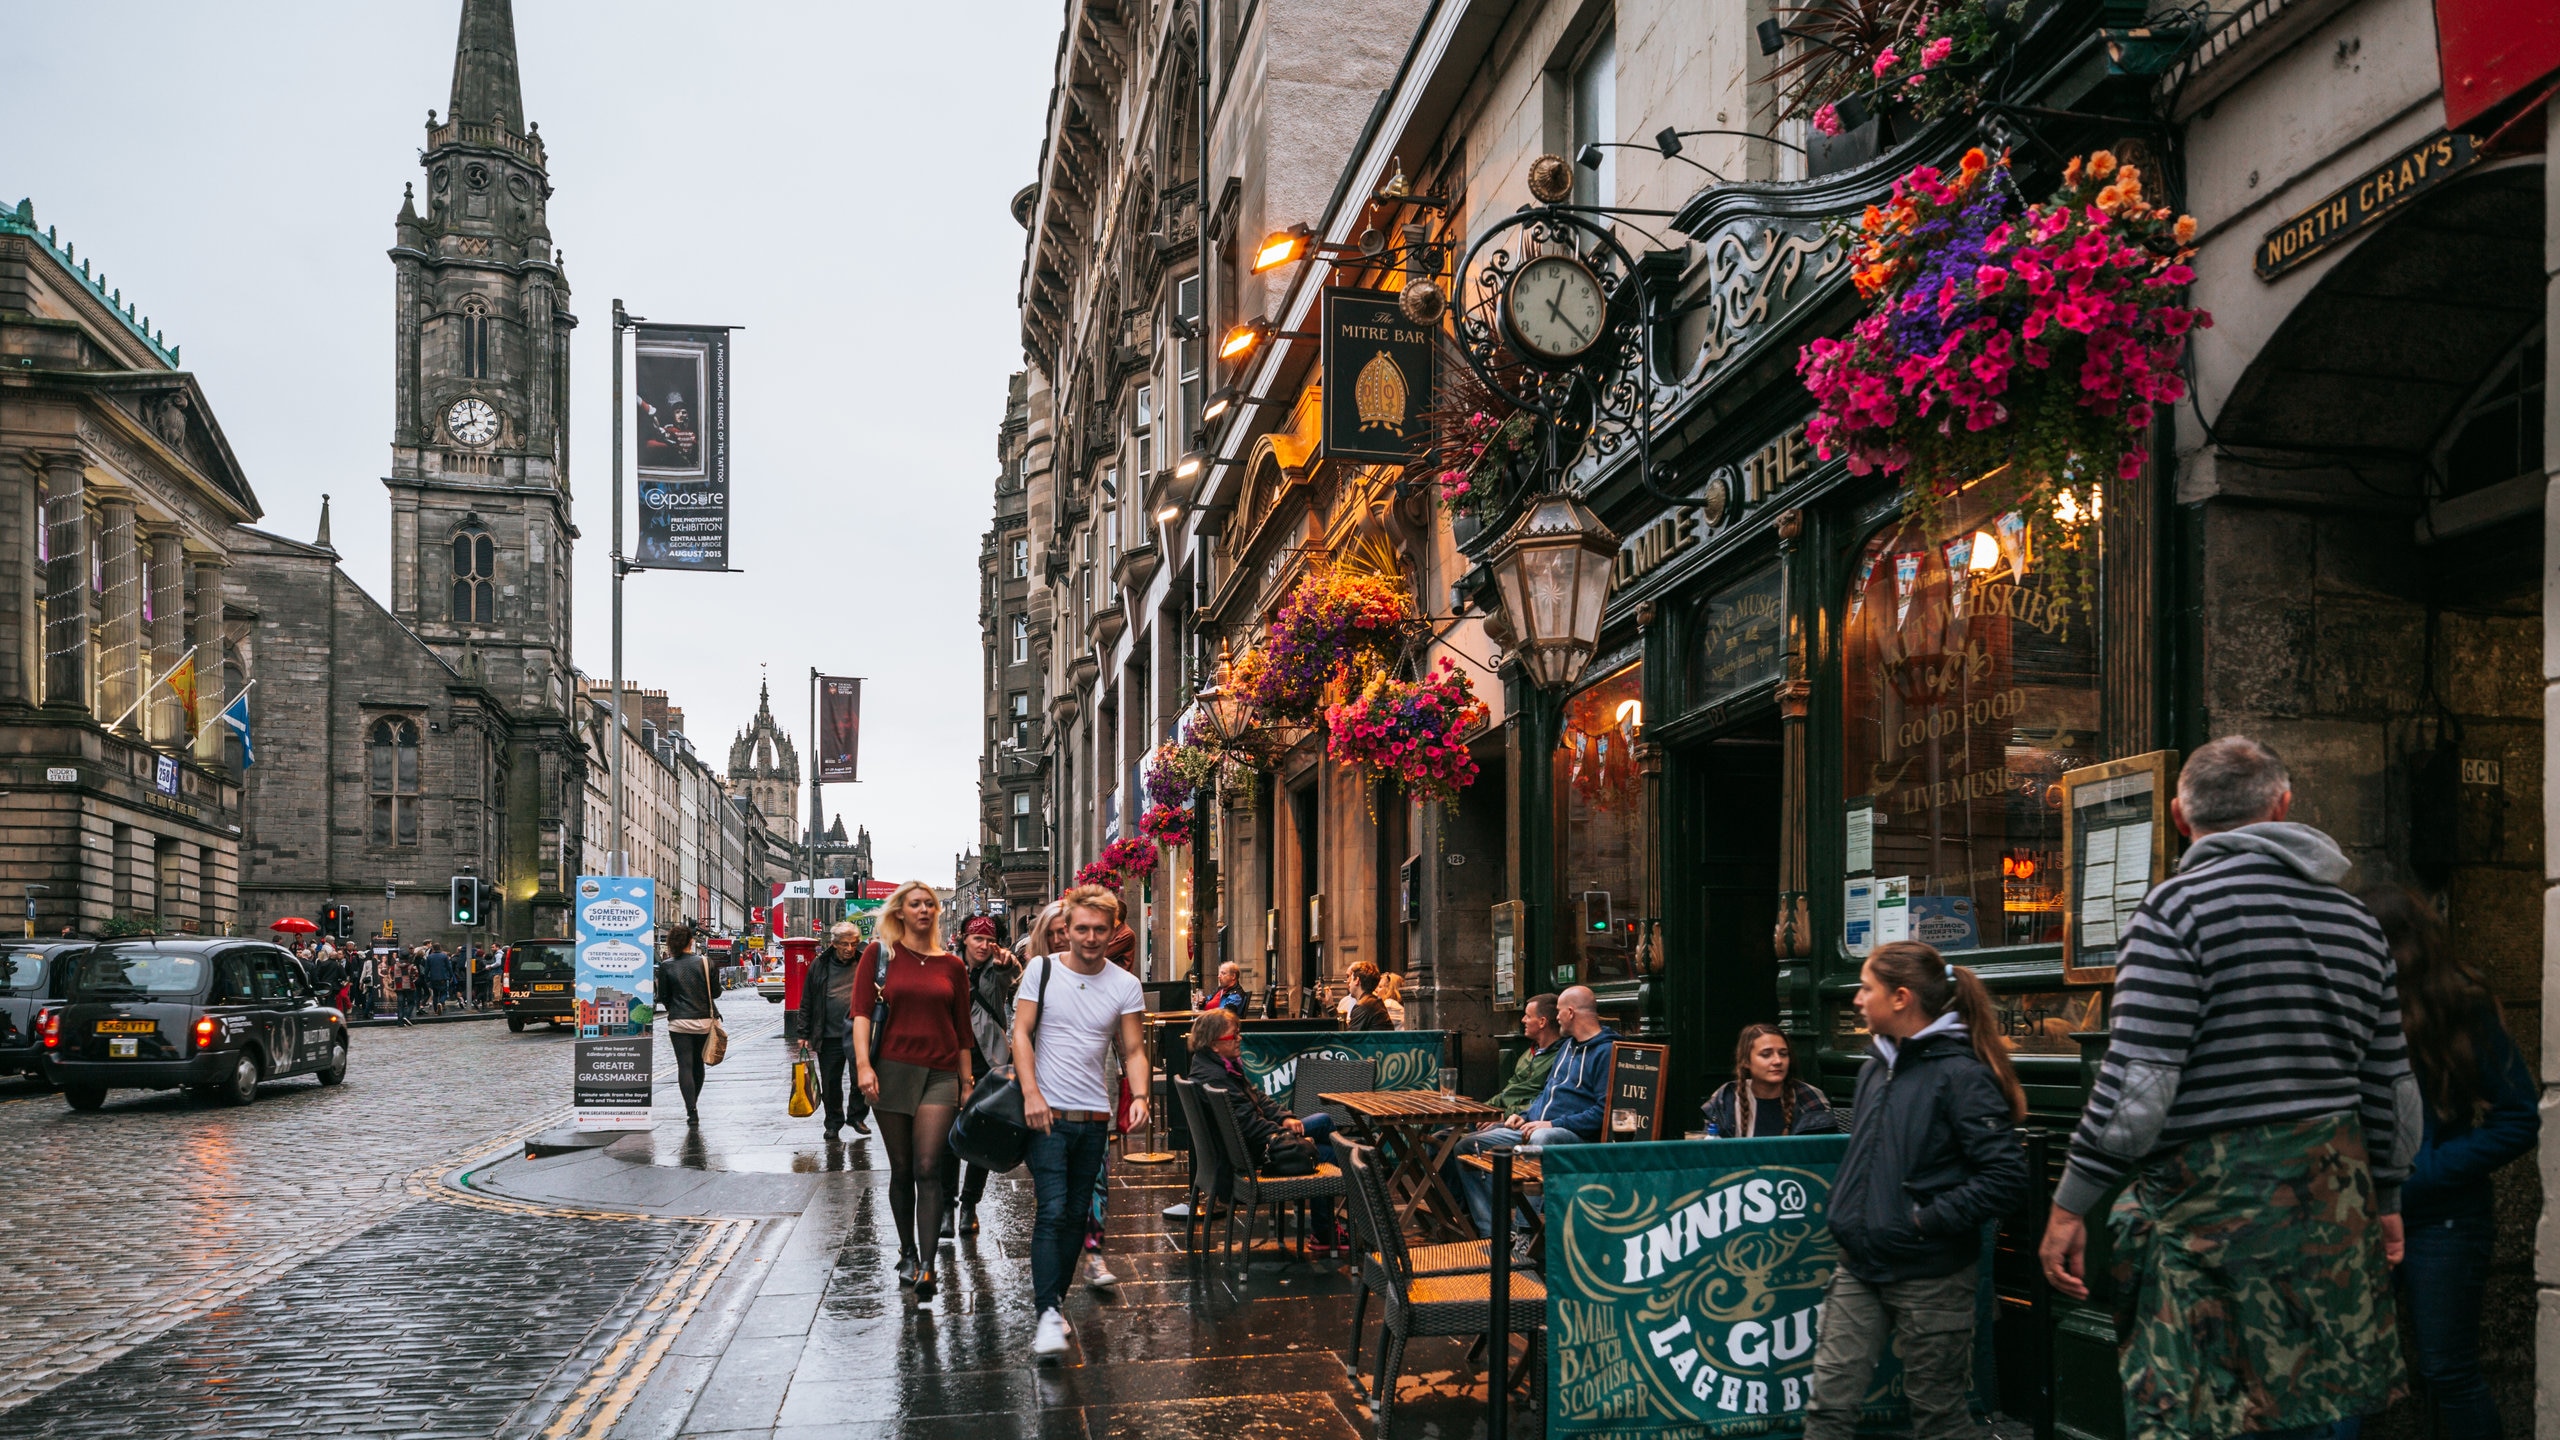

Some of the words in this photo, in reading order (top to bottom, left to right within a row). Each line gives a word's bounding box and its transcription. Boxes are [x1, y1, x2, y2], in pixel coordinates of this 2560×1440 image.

[2267, 197, 2348, 266] NORTH
[1532, 269, 1542, 282] 11
[1550, 265, 1561, 280] 12
[1568, 272, 1576, 285] 1
[1518, 282, 1530, 295] 10
[1580, 286, 1590, 299] 2
[1515, 302, 1524, 314] 9
[1586, 306, 1595, 318] 3
[1371, 311, 1395, 325] The
[1520, 319, 1530, 333] 8
[1341, 324, 1389, 342] MITRE
[1394, 328, 1426, 345] BAR
[1534, 335, 1543, 348] 7
[1551, 340, 1561, 353] 6
[1569, 336, 1579, 350] 5
[717, 431, 724, 440] OF
[1633, 505, 1700, 579] MILE
[1744, 423, 1810, 502] THE
[670, 523, 723, 532] EXHIBITION
[704, 550, 722, 558] 2015
[1931, 582, 2060, 635] WHISKIES
[1704, 606, 1735, 657] LIVE
[1737, 594, 1781, 623] MUSIC
[1898, 709, 1957, 748] GOOD
[1963, 687, 2026, 730] FOOD
[158, 767, 170, 783] 258
[1903, 781, 1947, 814] LIVE
[1952, 766, 2022, 805] MUSIC
[101, 1021, 128, 1032] SK60
[131, 1021, 150, 1032] VTY
[1997, 1009, 2049, 1037] BEST
[592, 1061, 635, 1070] GREATER
[578, 1073, 649, 1082] GRASSMARKET
[1622, 1084, 1648, 1100] LIVE
[1622, 1178, 1777, 1284] INNIS
[1777, 1179, 1807, 1219] &
[1557, 1298, 1618, 1348] SMALL
[1558, 1338, 1622, 1387] BATCH
[1647, 1314, 1769, 1415] LAGER
[1559, 1365, 1630, 1418] SCOTTISH
[1602, 1382, 1650, 1421] BEER
